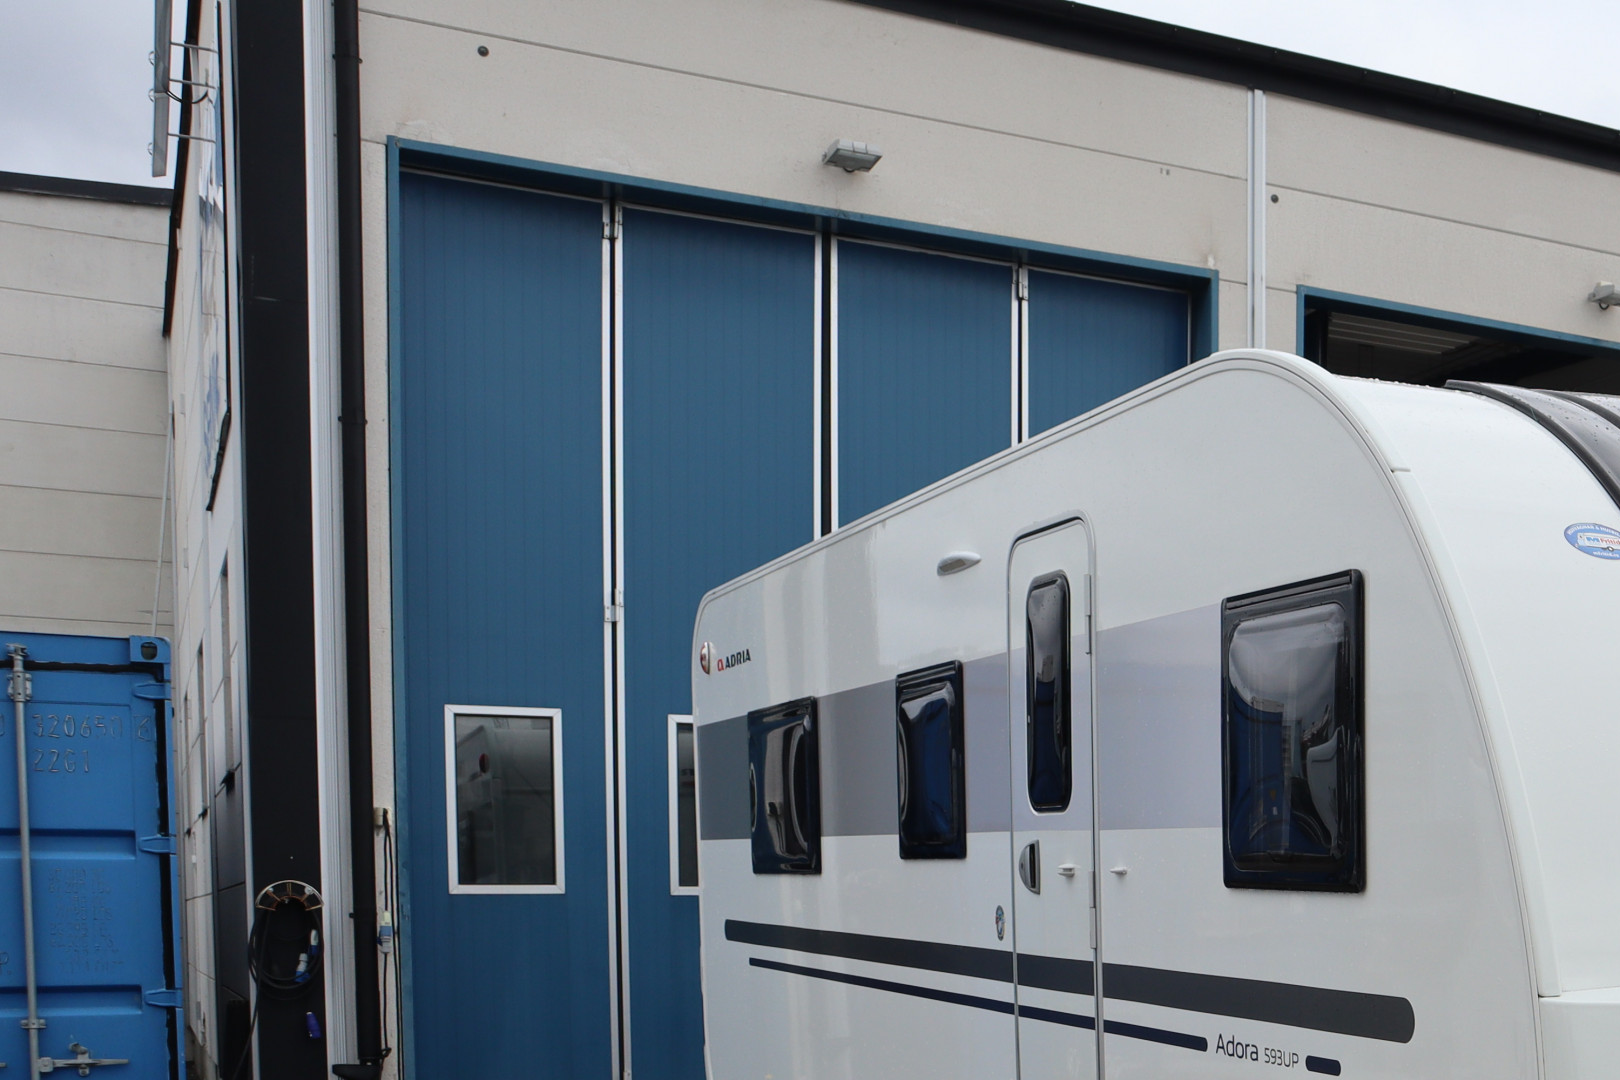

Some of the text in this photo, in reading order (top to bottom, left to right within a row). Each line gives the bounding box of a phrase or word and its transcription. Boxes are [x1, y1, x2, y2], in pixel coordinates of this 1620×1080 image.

[725, 648, 752, 669] ADRIA
[1215, 1033, 1300, 1069] Adora 593UP
